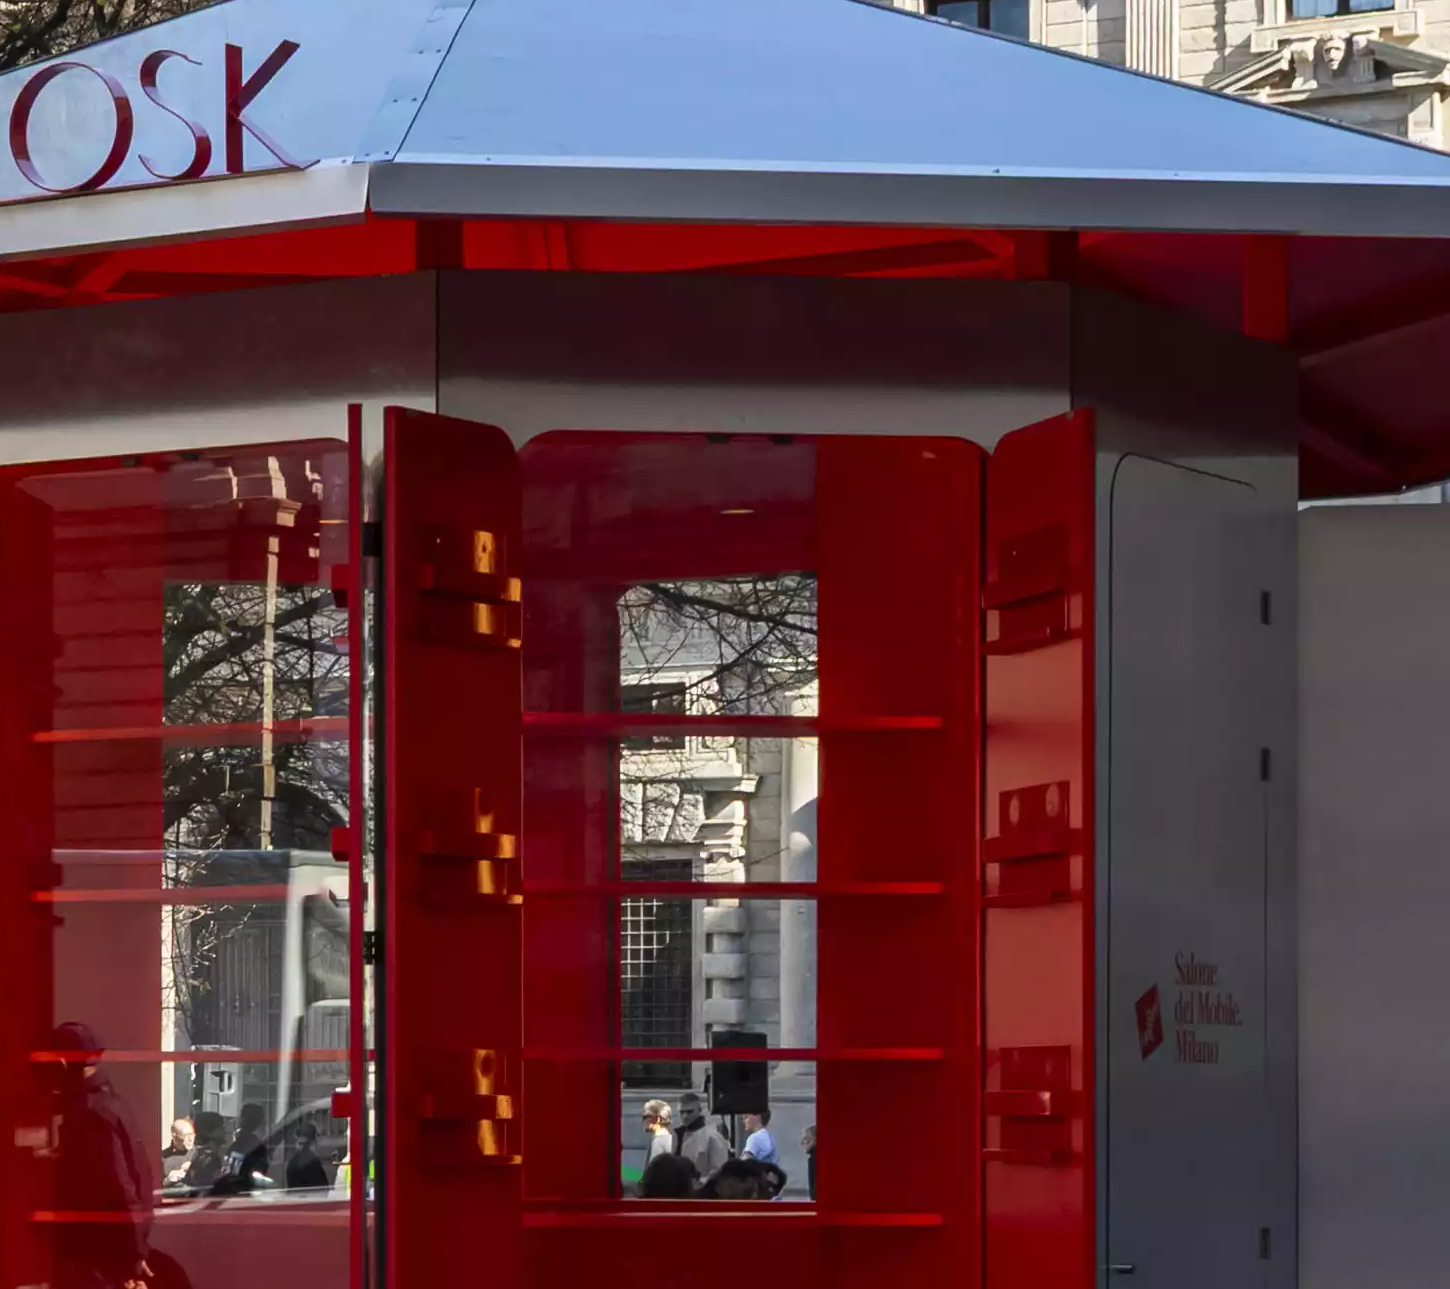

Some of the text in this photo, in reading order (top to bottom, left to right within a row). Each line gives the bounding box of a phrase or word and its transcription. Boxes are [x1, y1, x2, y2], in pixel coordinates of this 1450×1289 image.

[1174, 950, 1218, 986] Salone
[1174, 990, 1194, 1025] del
[1175, 1029, 1219, 1064] Milano
